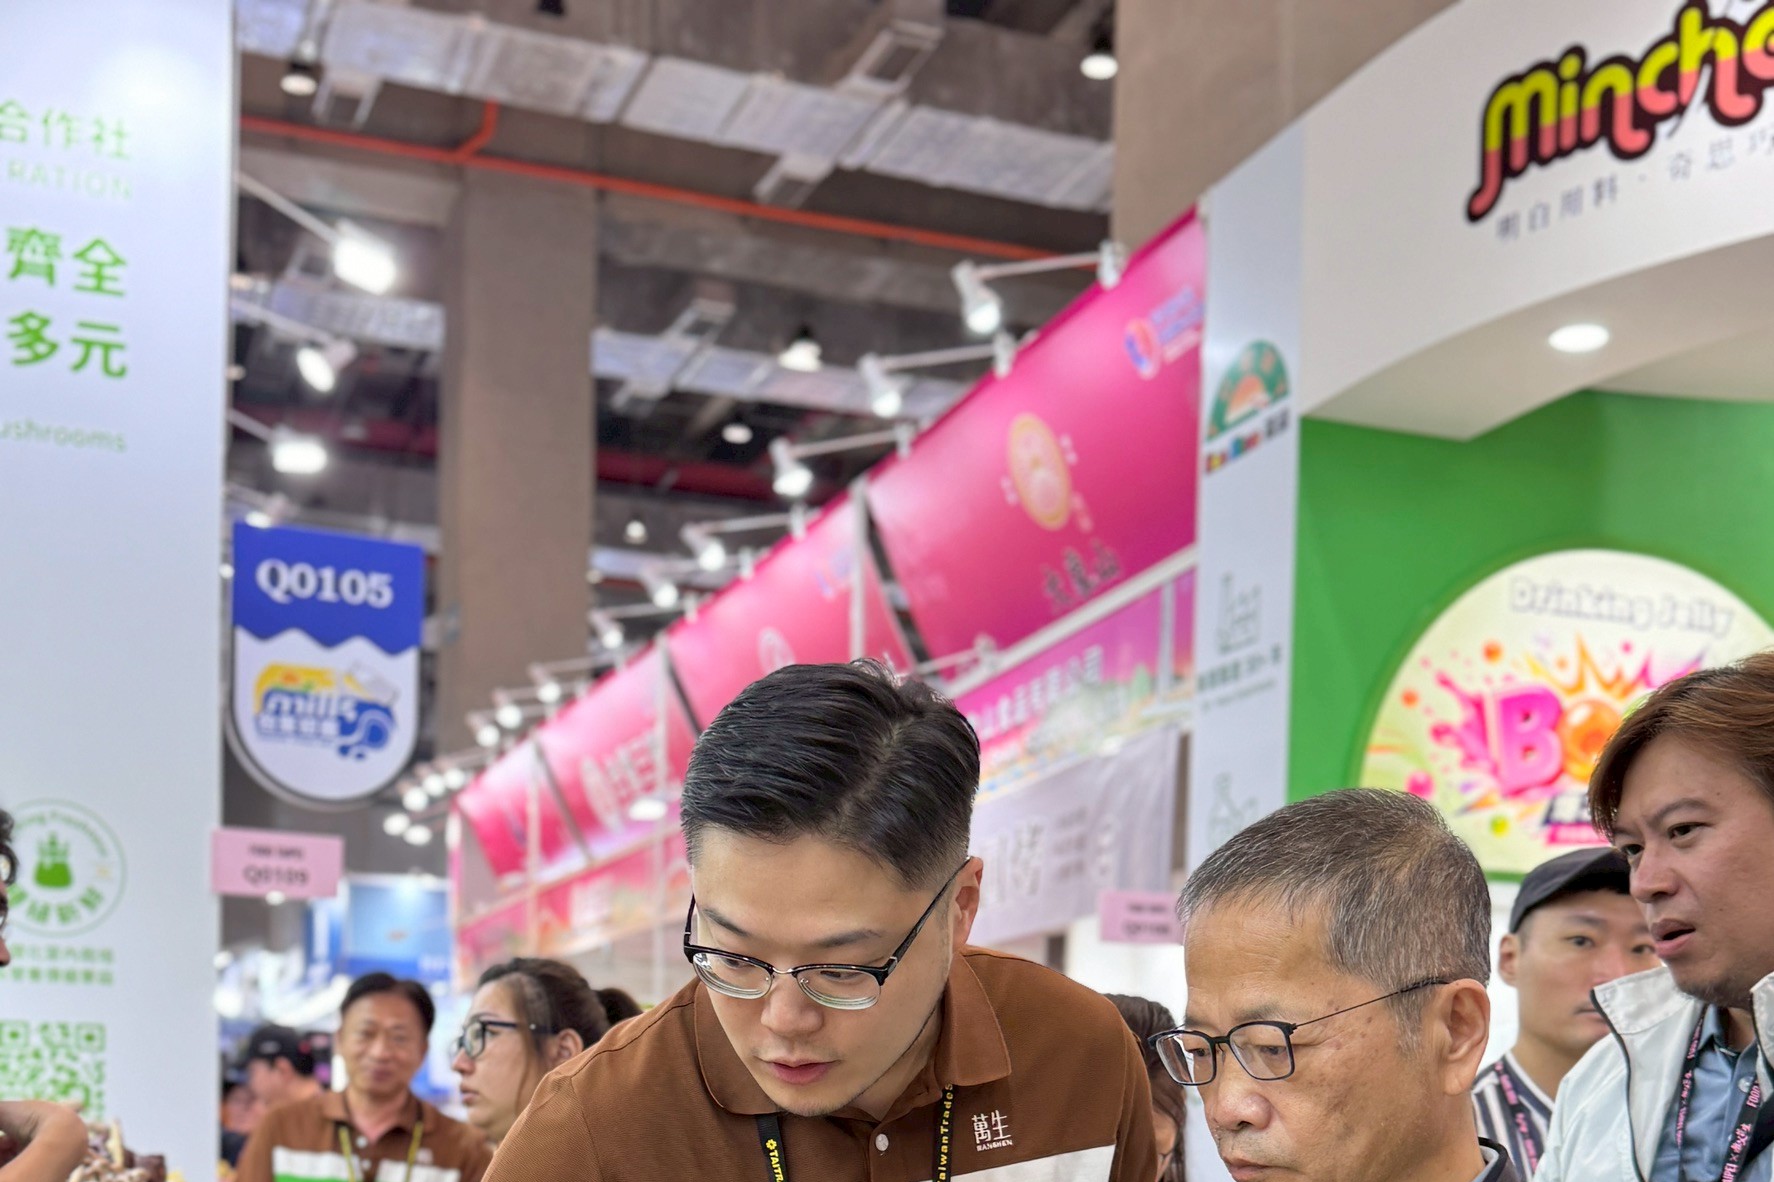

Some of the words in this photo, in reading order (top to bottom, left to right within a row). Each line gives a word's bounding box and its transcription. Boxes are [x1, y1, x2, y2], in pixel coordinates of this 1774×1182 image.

[6, 227, 128, 297] 齊全
[6, 310, 128, 379] 多元
[255, 558, 394, 608] Q0105
[1496, 684, 1628, 798] BO
[971, 1109, 1012, 1144] 萬生
